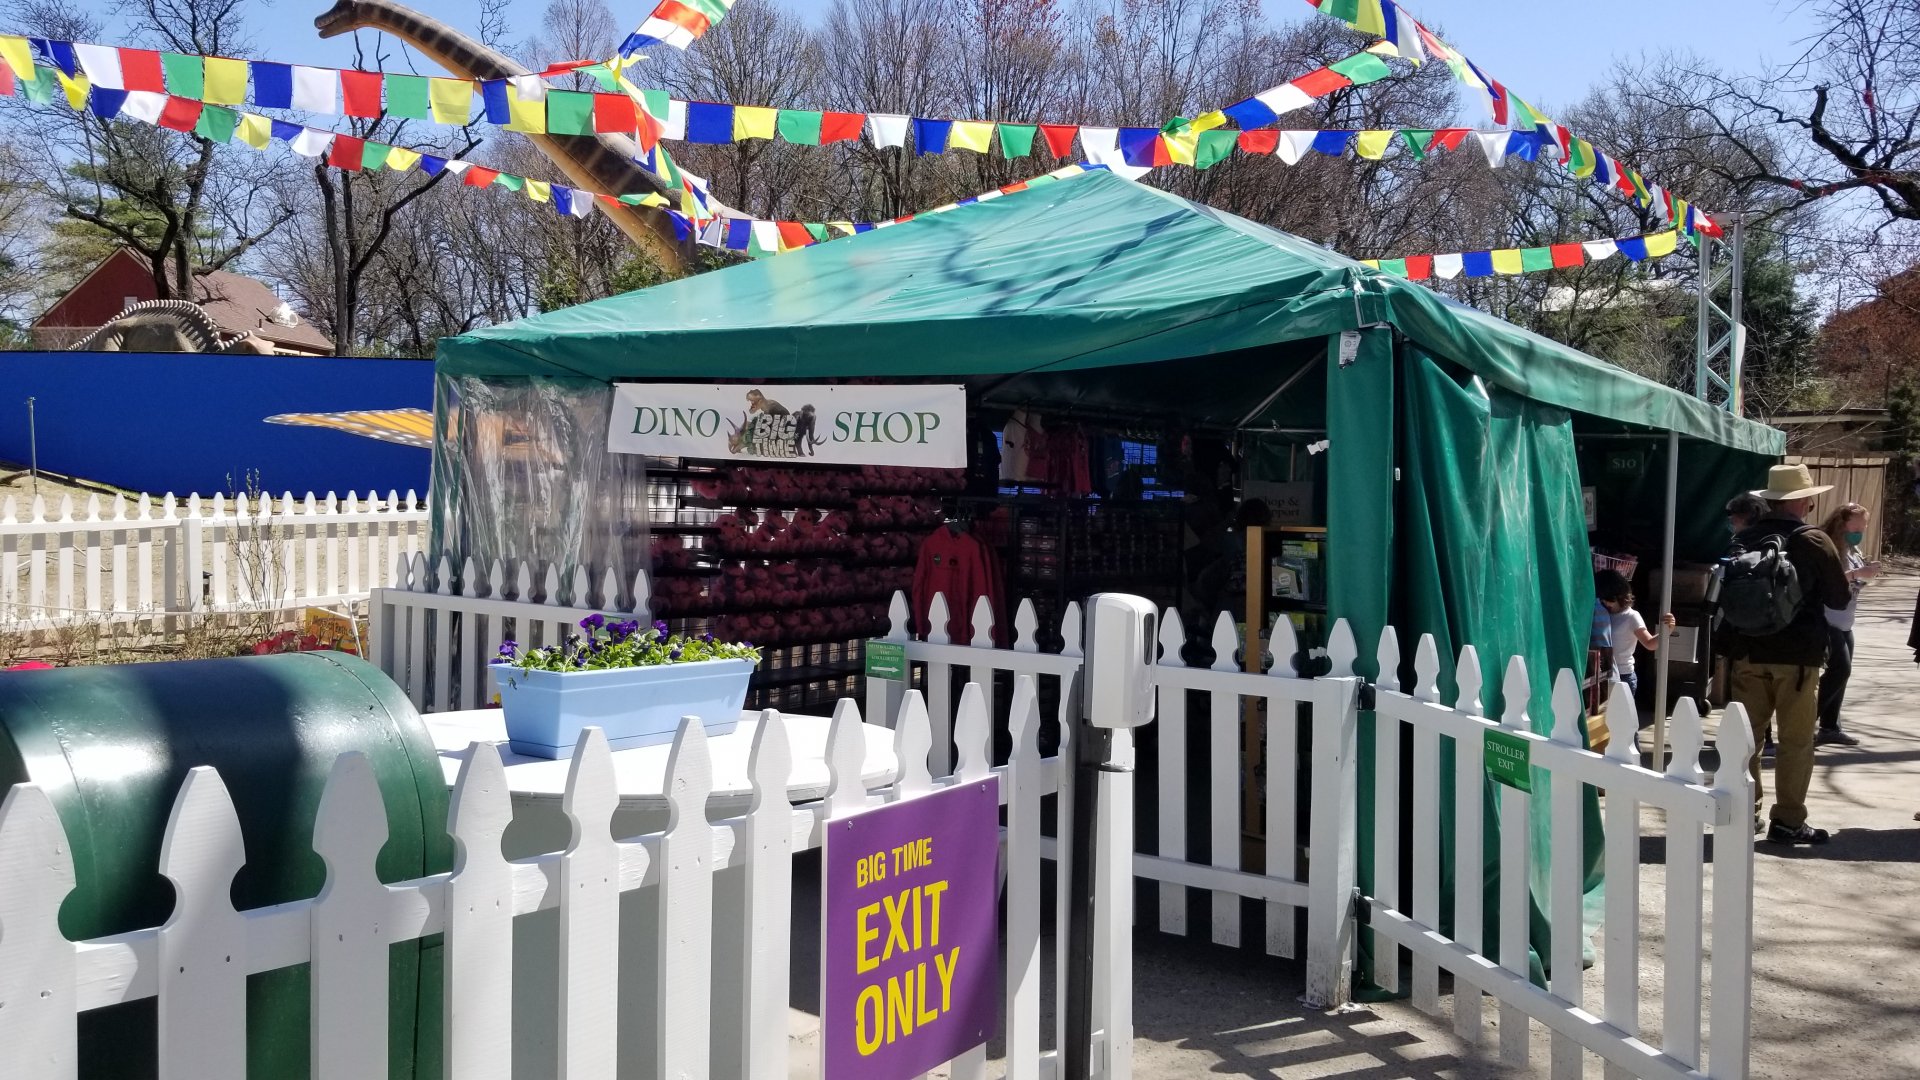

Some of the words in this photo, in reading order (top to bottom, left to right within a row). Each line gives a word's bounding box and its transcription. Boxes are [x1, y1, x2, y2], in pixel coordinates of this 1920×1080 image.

[631, 406, 721, 438] DINO
[832, 411, 941, 444] SHOP
[752, 414, 798, 440] BIG
[752, 438, 798, 458] TIME
[1486, 740, 1525, 761] STROLLER
[1497, 757, 1515, 771] EXIT
[856, 851, 886, 888] BIG
[891, 837, 932, 876] TIME
[856, 880, 948, 975] EXIT
[855, 946, 960, 1056] ONLY
